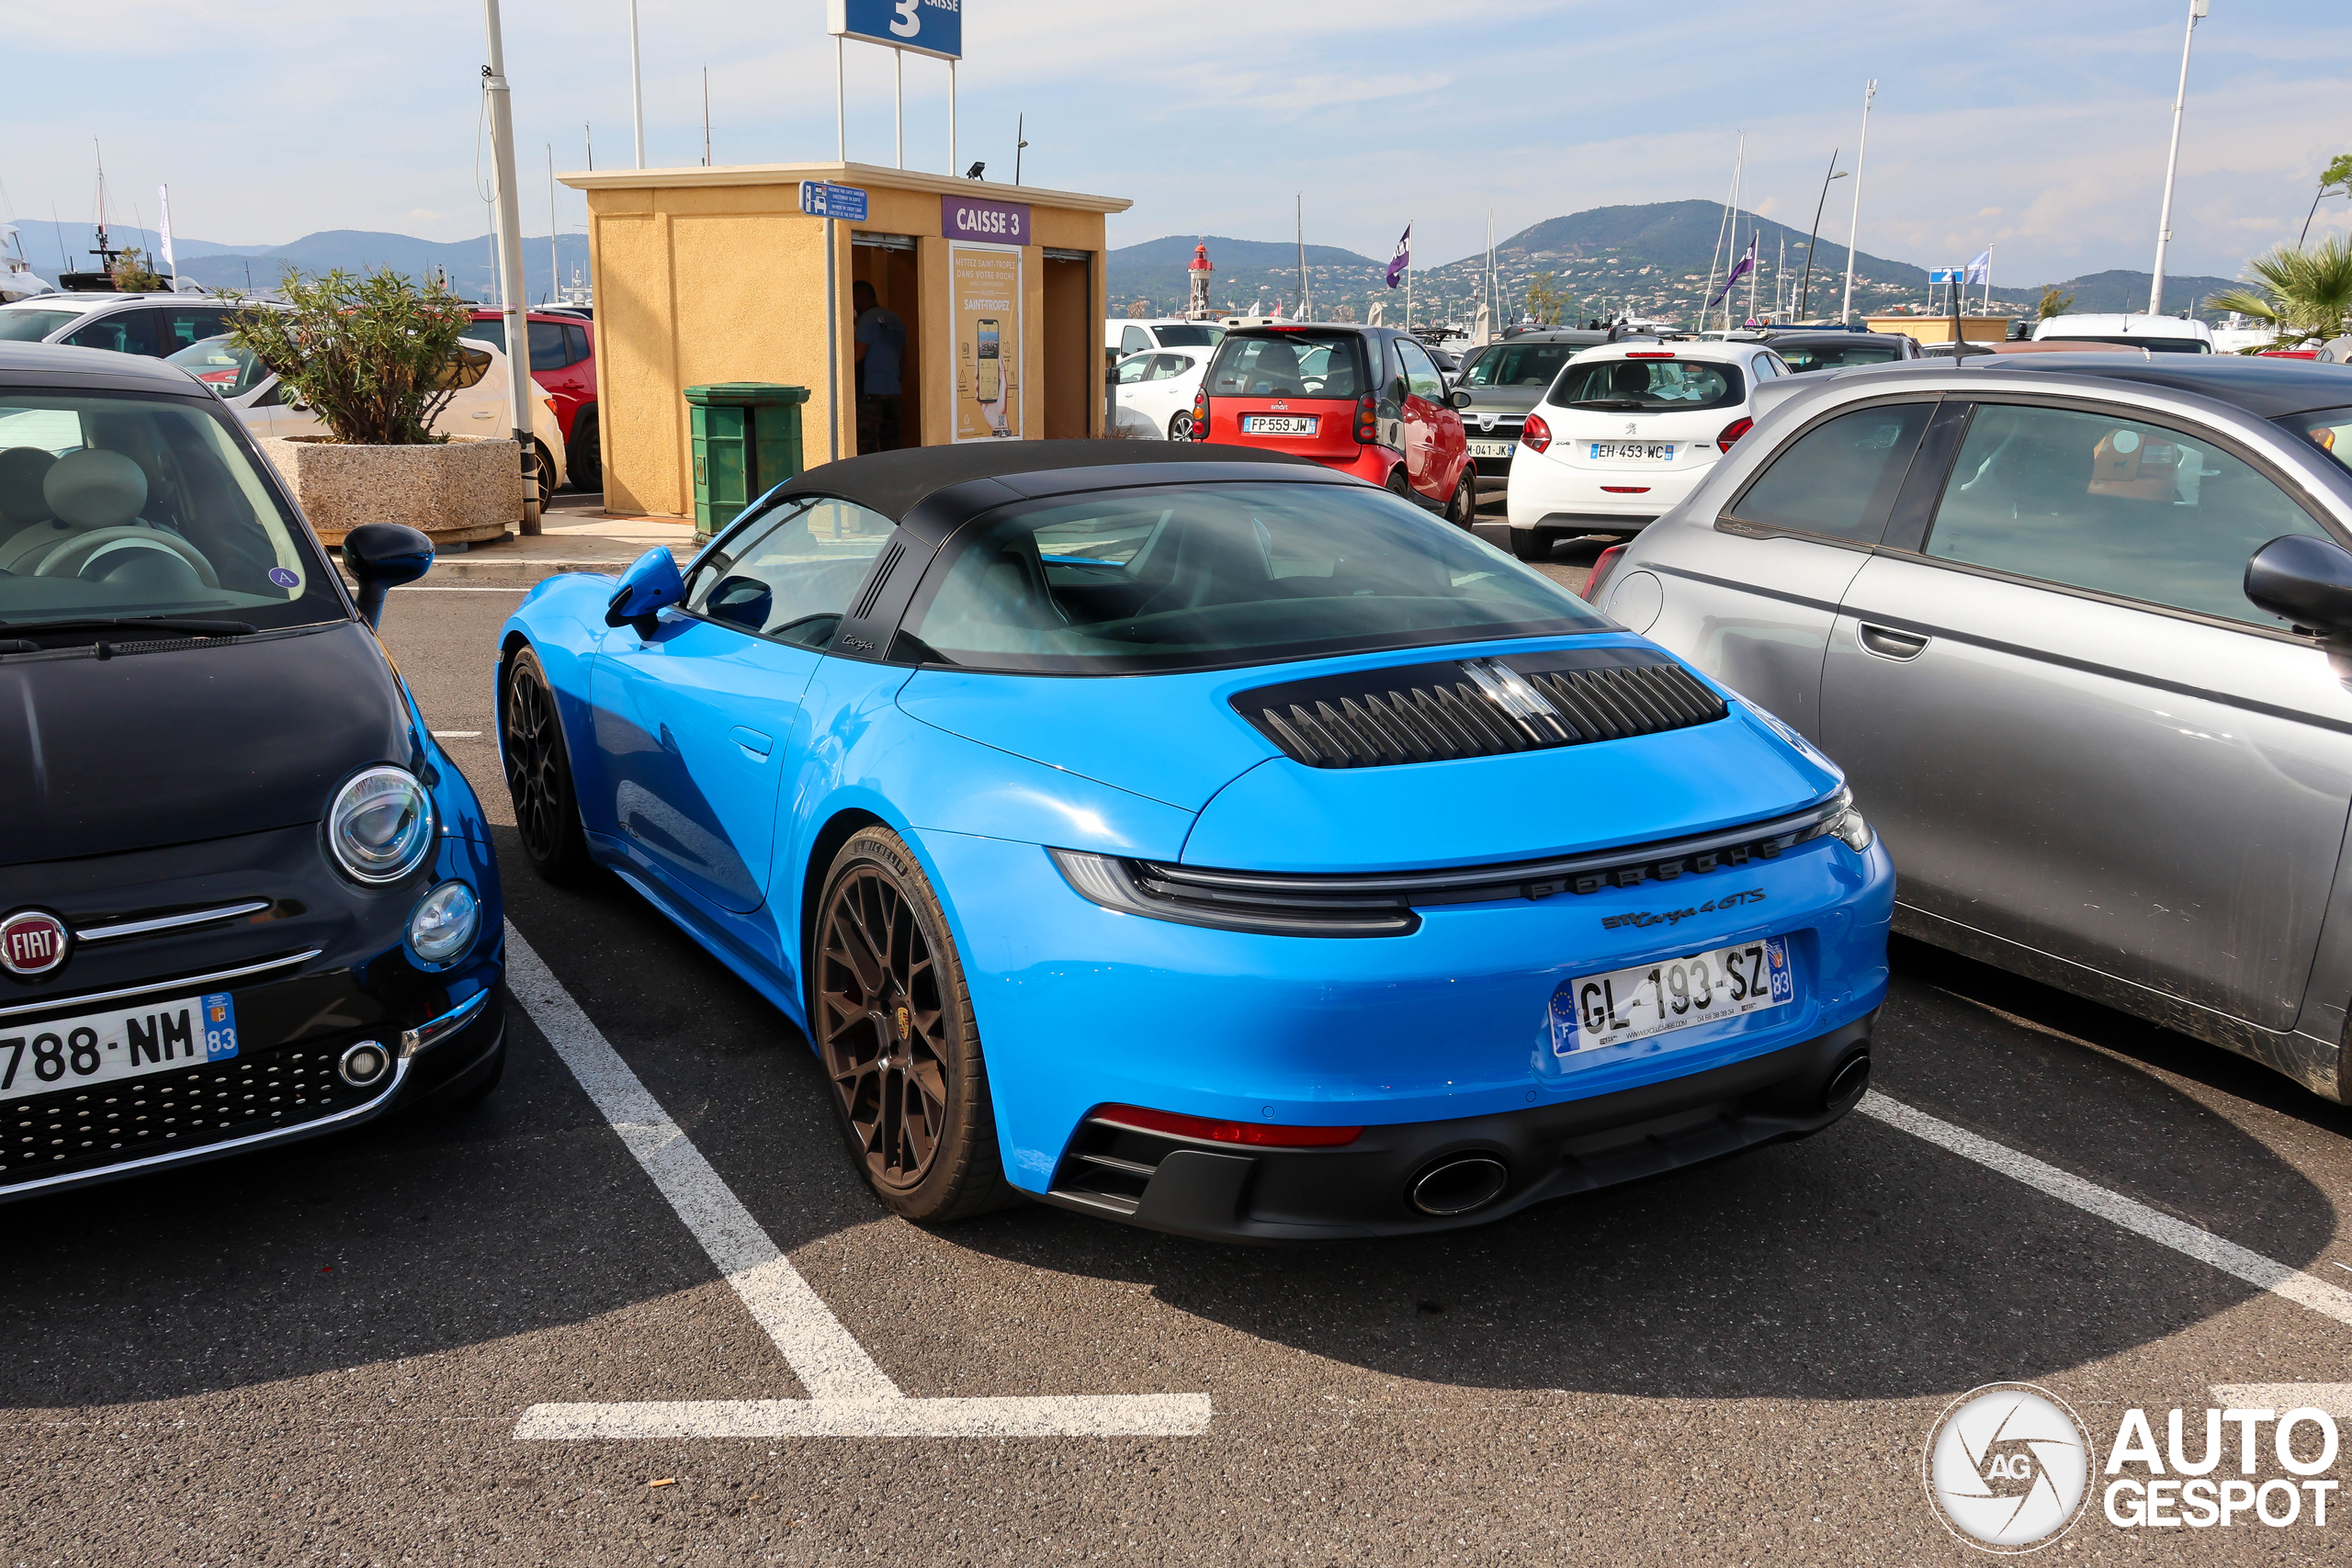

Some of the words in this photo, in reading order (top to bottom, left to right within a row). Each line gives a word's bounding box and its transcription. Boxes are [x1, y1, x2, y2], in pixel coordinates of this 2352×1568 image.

[889, 0, 921, 38] 3
[956, 208, 1006, 233] CAISSE
[1011, 213, 1020, 235] 3
[956, 258, 977, 267] METTEZ
[978, 259, 1016, 269] SAINT-TROPEZ
[956, 270, 974, 278] DANS
[976, 271, 994, 279] VOTRE
[996, 272, 1014, 280] POCHE
[1941, 267, 1952, 282] 2
[964, 299, 1010, 310] SAINT-TROPEZ
[1251, 418, 1308, 432] FP-559-JW
[1599, 445, 1664, 458] EH-453-WC
[278, 570, 295, 584] A
[842, 633, 876, 651] targa
[863, 840, 906, 874] MICHELIN
[1530, 840, 1781, 901] PORSCHE
[1699, 899, 1716, 913] 4
[1717, 887, 1767, 909] GTS
[11, 929, 52, 961] FIAT
[1580, 946, 1768, 1034] GL-193-SZ
[1772, 971, 1790, 995] 83
[0, 1009, 194, 1089] 788-NM
[207, 1028, 236, 1053] 83
